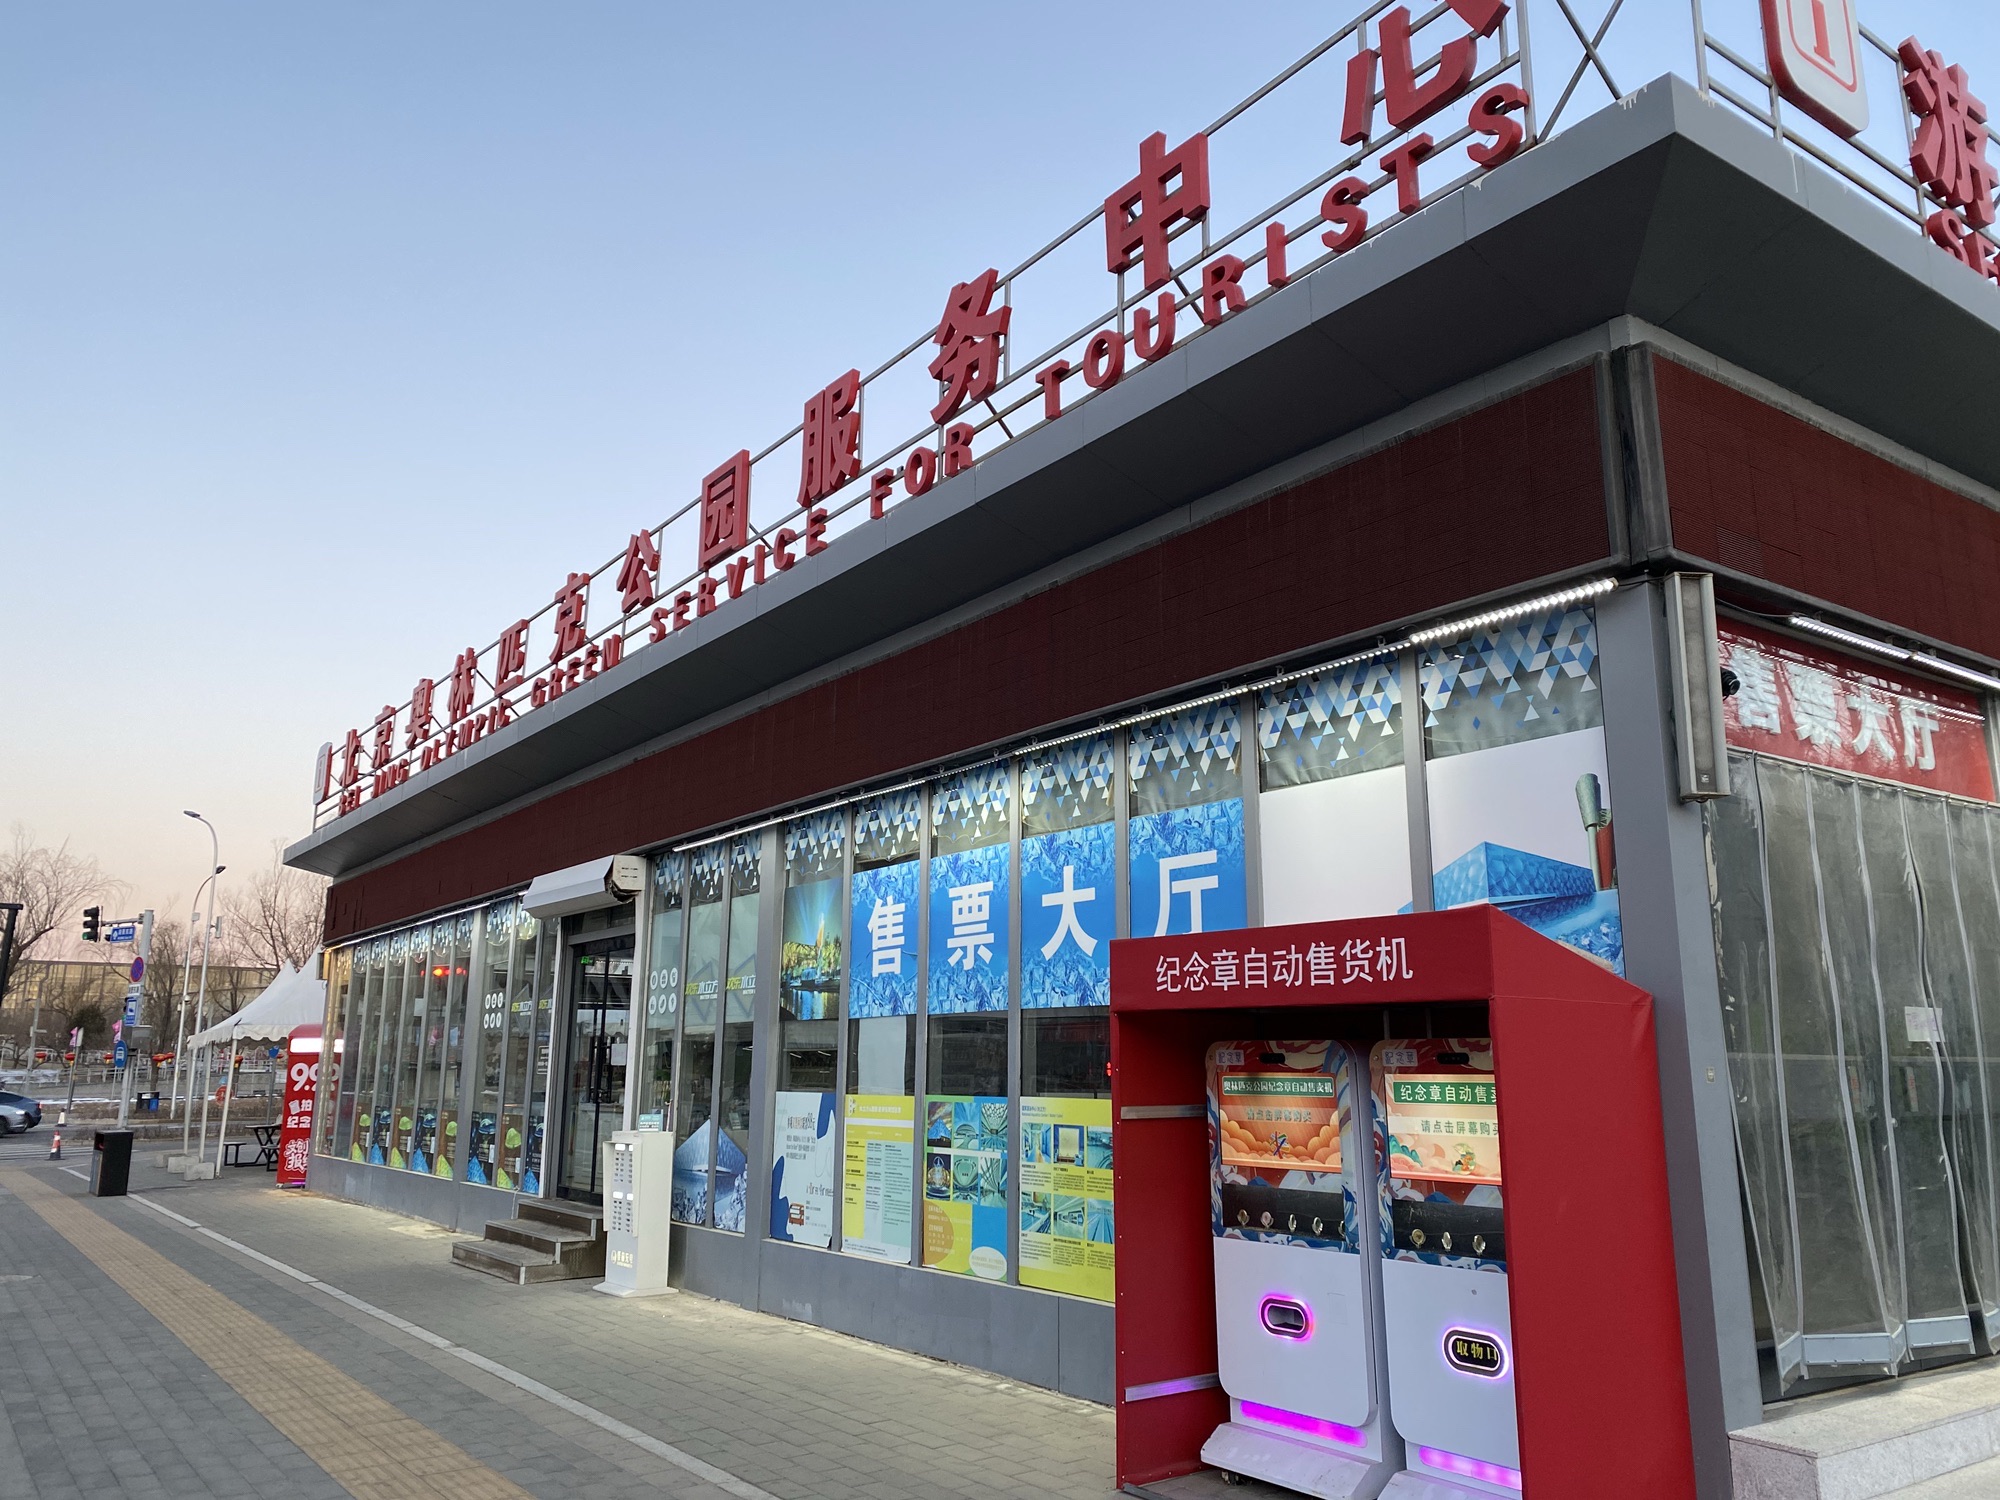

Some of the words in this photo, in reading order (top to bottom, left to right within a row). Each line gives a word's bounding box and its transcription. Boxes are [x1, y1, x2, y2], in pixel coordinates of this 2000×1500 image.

[371, 758, 409, 799] JING
[420, 698, 511, 771] OLYMPIC
[530, 634, 621, 708] GREEN
[649, 507, 829, 643] SERVICE
[870, 421, 974, 520] FOR
[1035, 82, 1530, 420] TOURISTS
[867, 849, 1220, 978] 售票大厅
[1155, 936, 1414, 993] 纪念章自动售货机
[1456, 1340, 1498, 1361] 取物口
